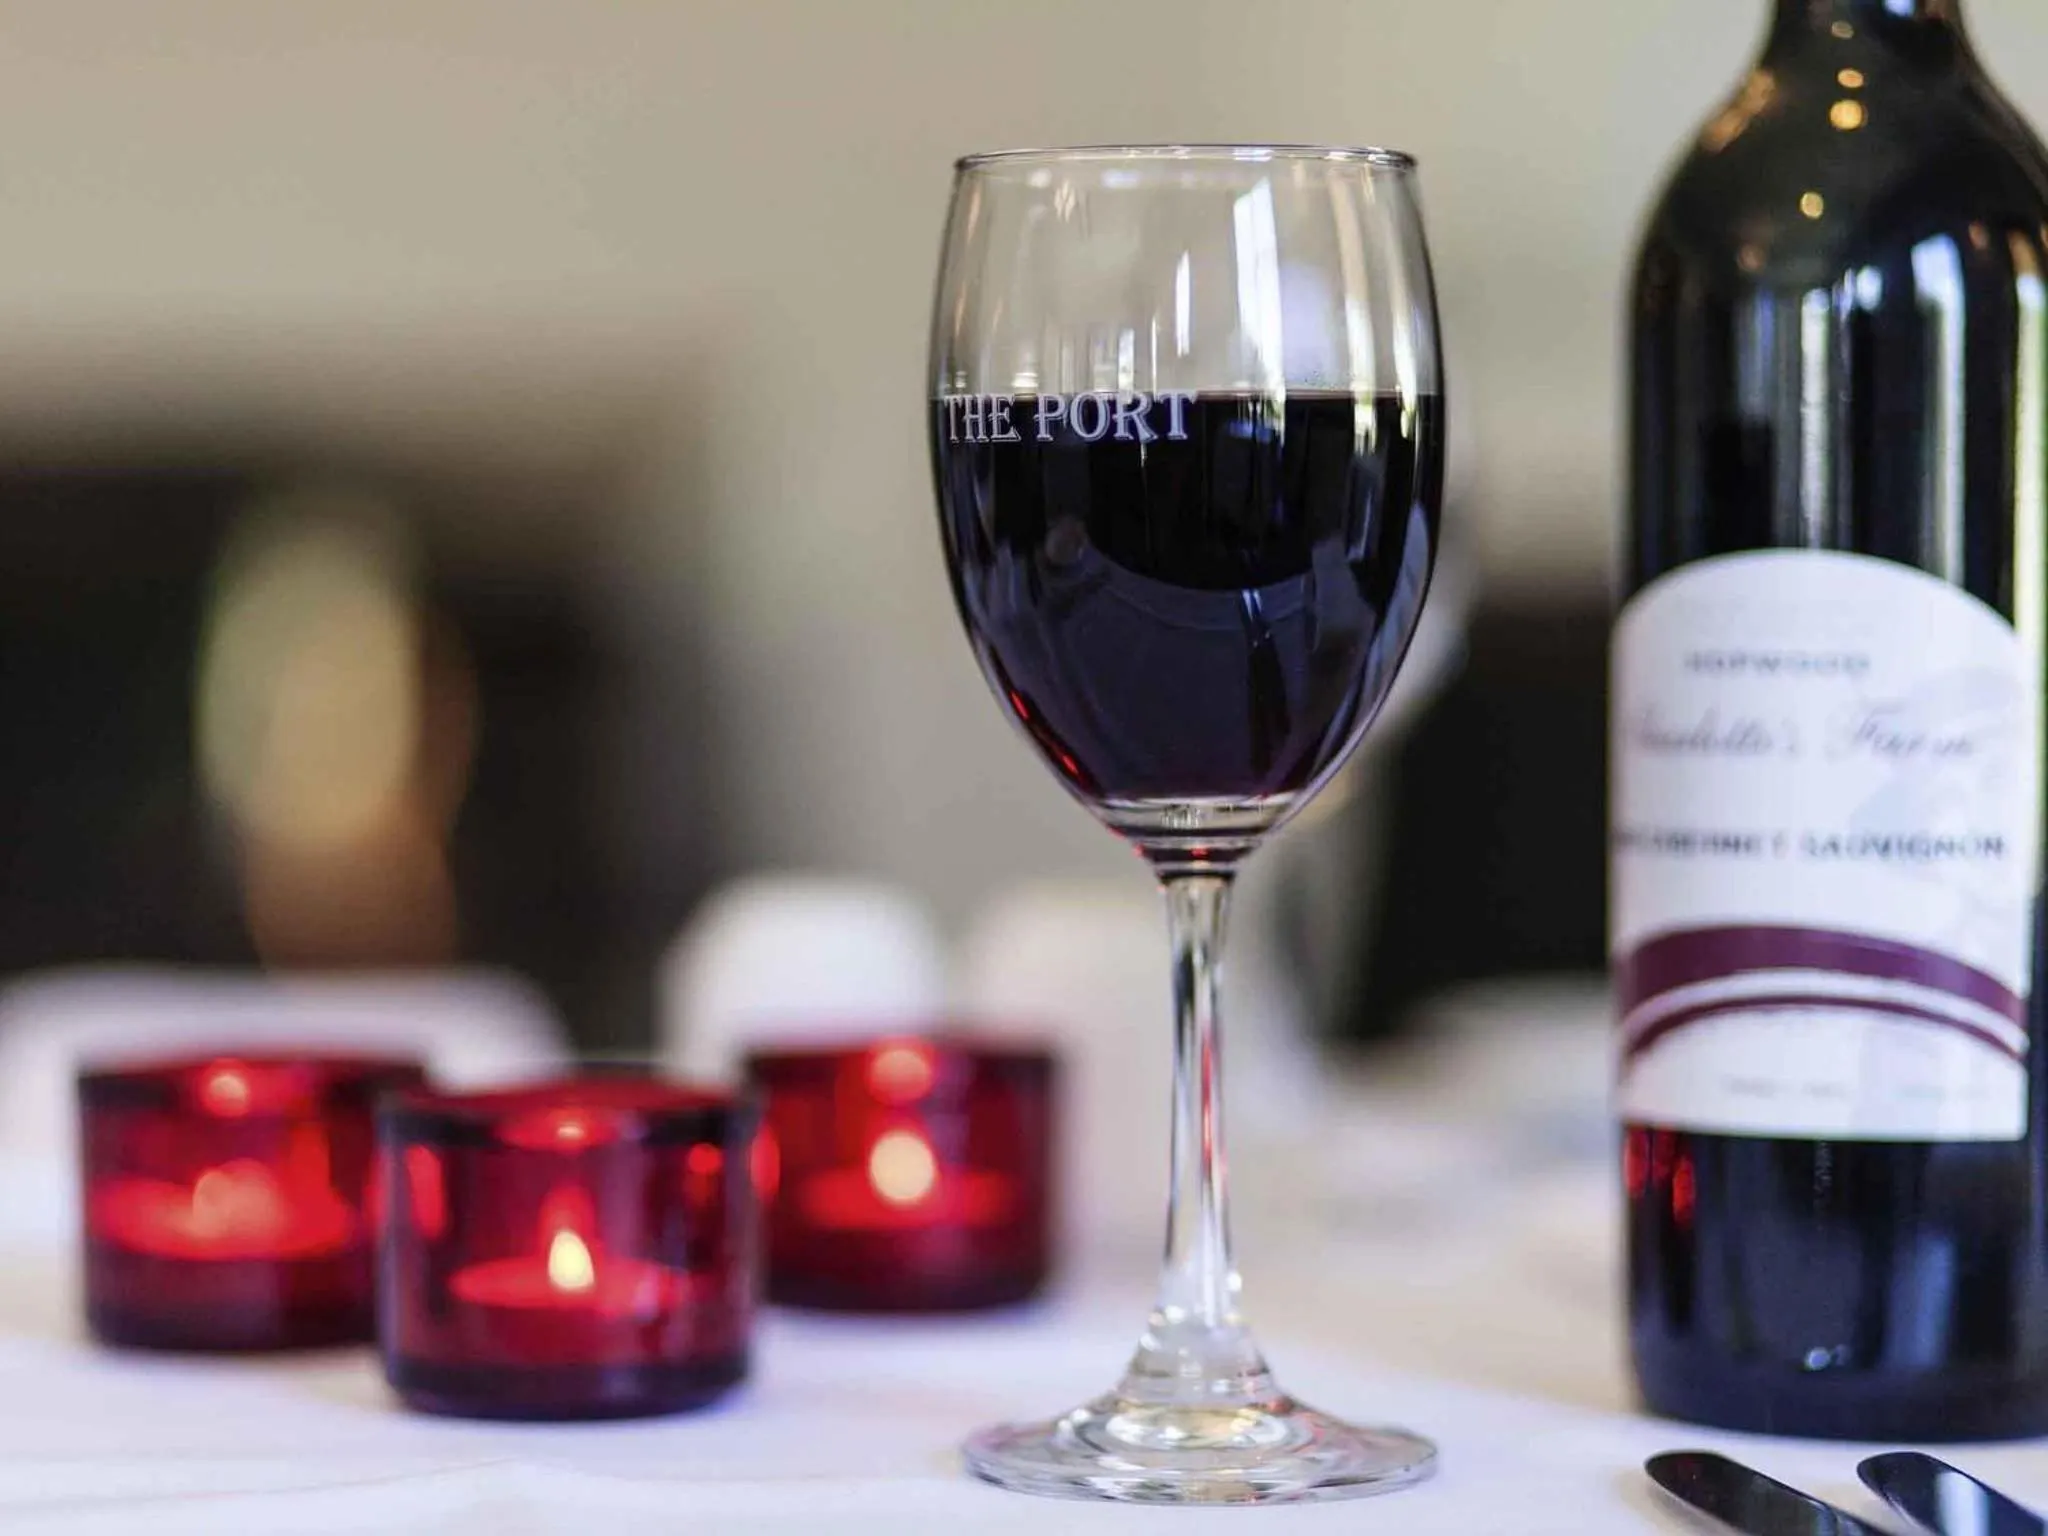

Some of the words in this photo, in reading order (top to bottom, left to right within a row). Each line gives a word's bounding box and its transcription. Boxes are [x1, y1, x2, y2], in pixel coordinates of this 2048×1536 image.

[944, 390, 1021, 443] THE
[1033, 386, 1197, 442] PORT
[1801, 831, 2006, 863] SAUVIGNON
